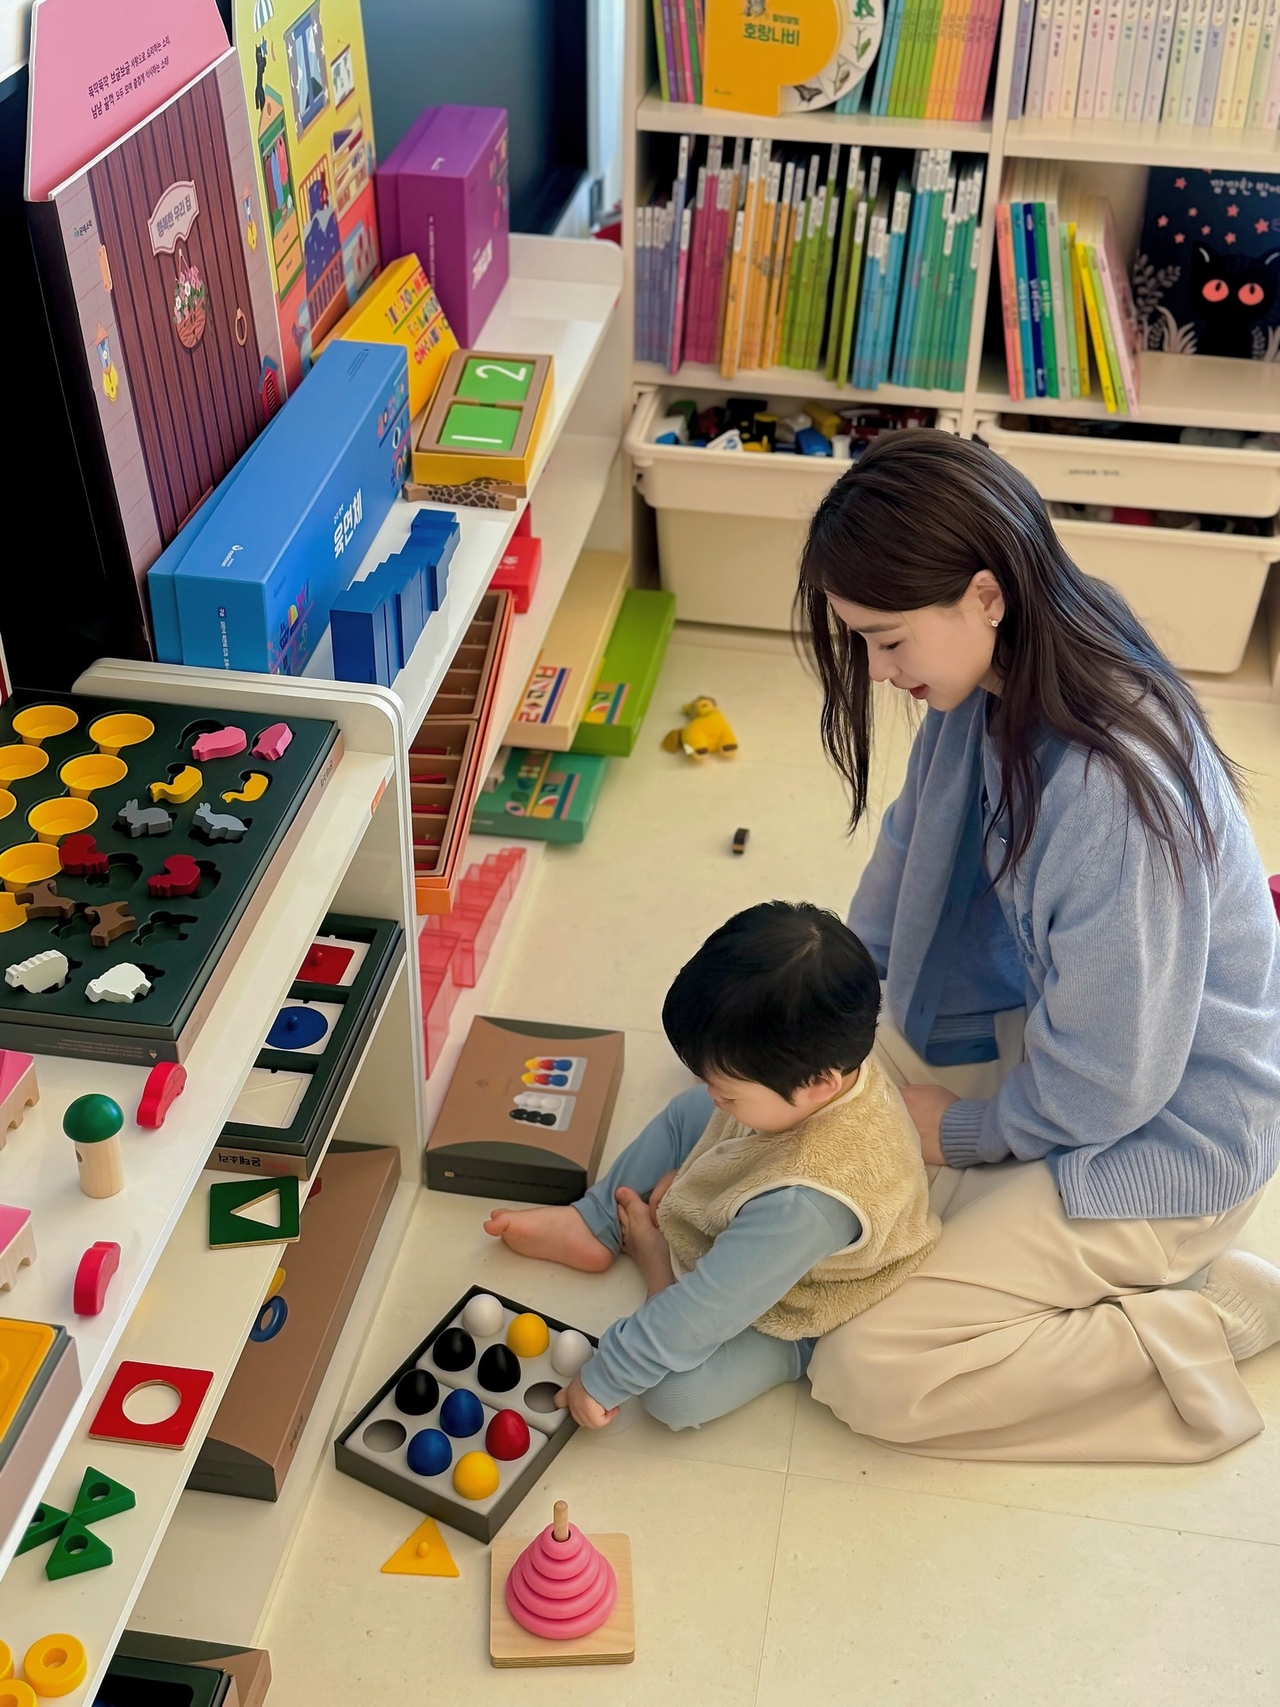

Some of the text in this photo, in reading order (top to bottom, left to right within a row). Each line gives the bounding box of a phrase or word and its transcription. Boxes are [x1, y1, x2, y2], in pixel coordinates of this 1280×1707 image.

[743, 22, 800, 47] 호랑나비
[88, 75, 109, 98] 뚝딱뚝딱
[110, 61, 130, 84] 보글보글
[91, 101, 103, 119] 냠냠
[103, 93, 115, 111] 꿀꺽
[115, 87, 124, 101] 모두
[1209, 176, 1254, 196] 깜깜한
[156, 194, 192, 238] 행복한 우리 집
[475, 363, 527, 383] 2
[332, 488, 363, 559] 육면체
